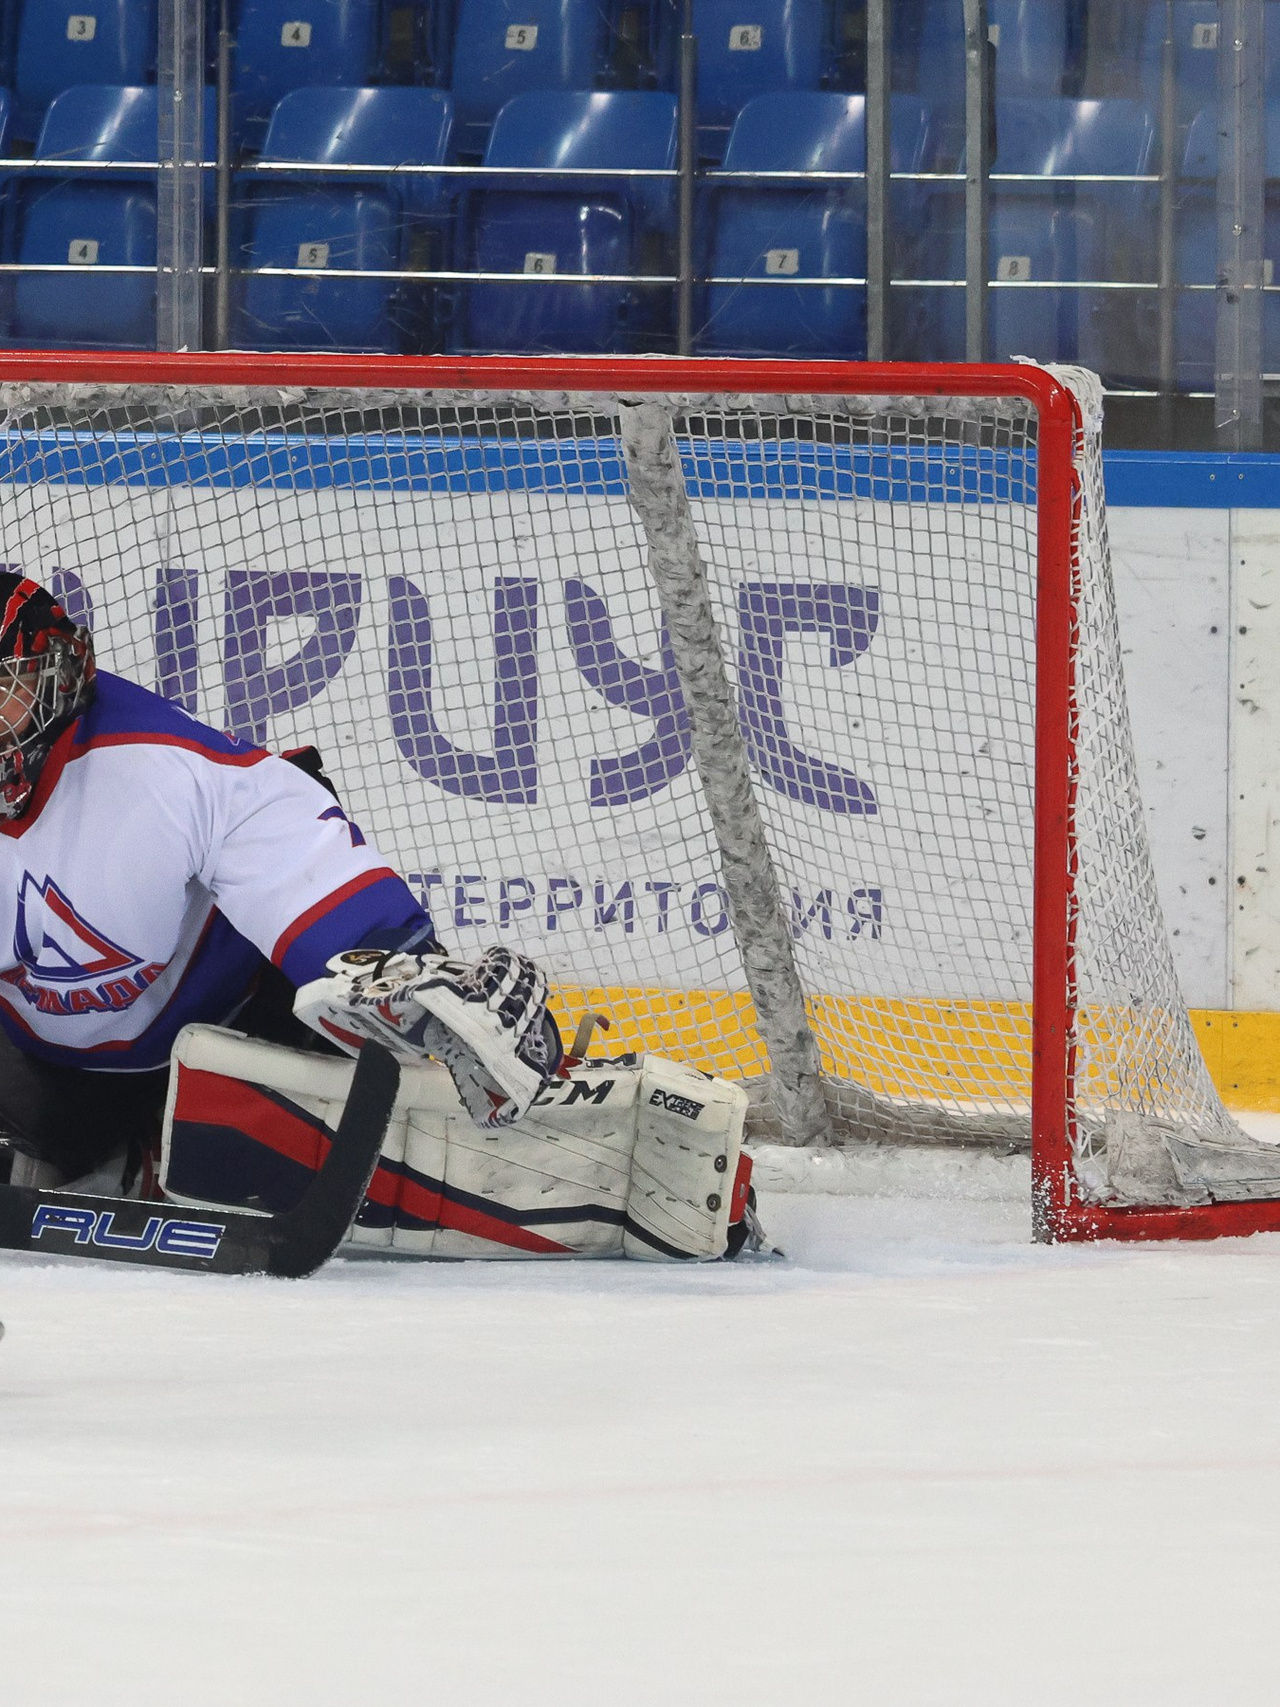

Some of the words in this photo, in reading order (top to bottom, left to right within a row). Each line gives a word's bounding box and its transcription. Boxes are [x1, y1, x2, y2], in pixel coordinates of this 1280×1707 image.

[408, 873, 882, 941] ТЕРРИТОИЯ
[531, 1080, 616, 1105] CM
[31, 1204, 226, 1259] RUE
